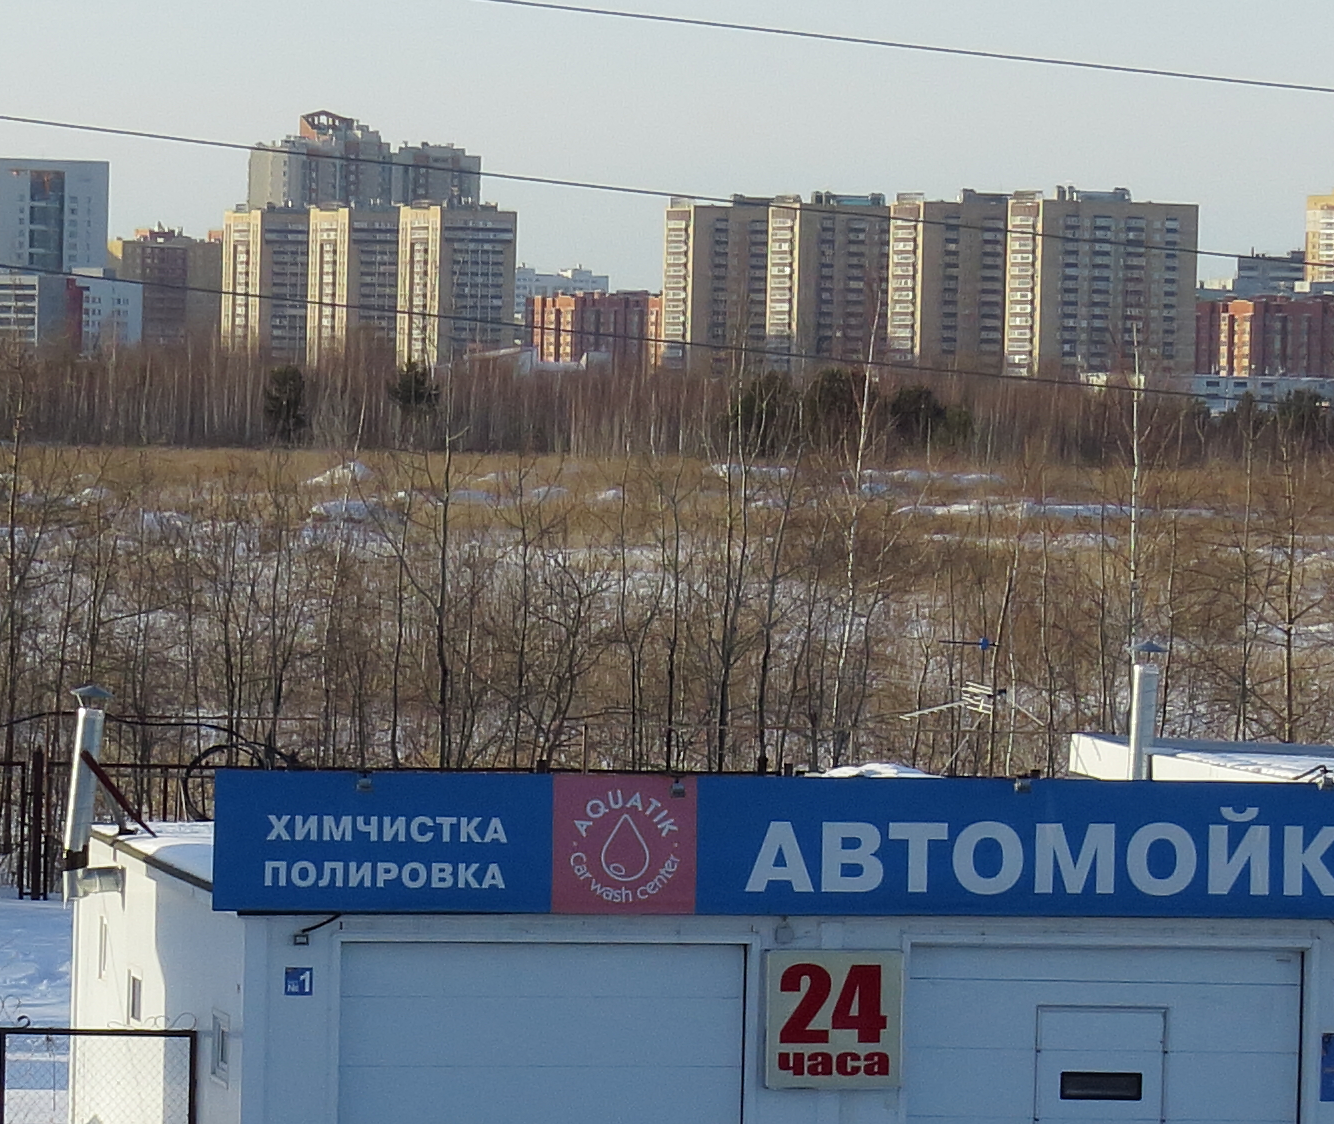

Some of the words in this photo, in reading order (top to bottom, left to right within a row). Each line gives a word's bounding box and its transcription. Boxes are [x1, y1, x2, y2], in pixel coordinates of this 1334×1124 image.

[266, 815, 507, 844] ХИМЧИСТКА
[574, 789, 678, 837] AQUATIK
[264, 861, 506, 889] ПОЛИРОВКА
[570, 852, 592, 880] Car
[590, 878, 632, 902] wash
[637, 854, 680, 899] center
[778, 963, 887, 1044] 24
[778, 1051, 890, 1077] часа
